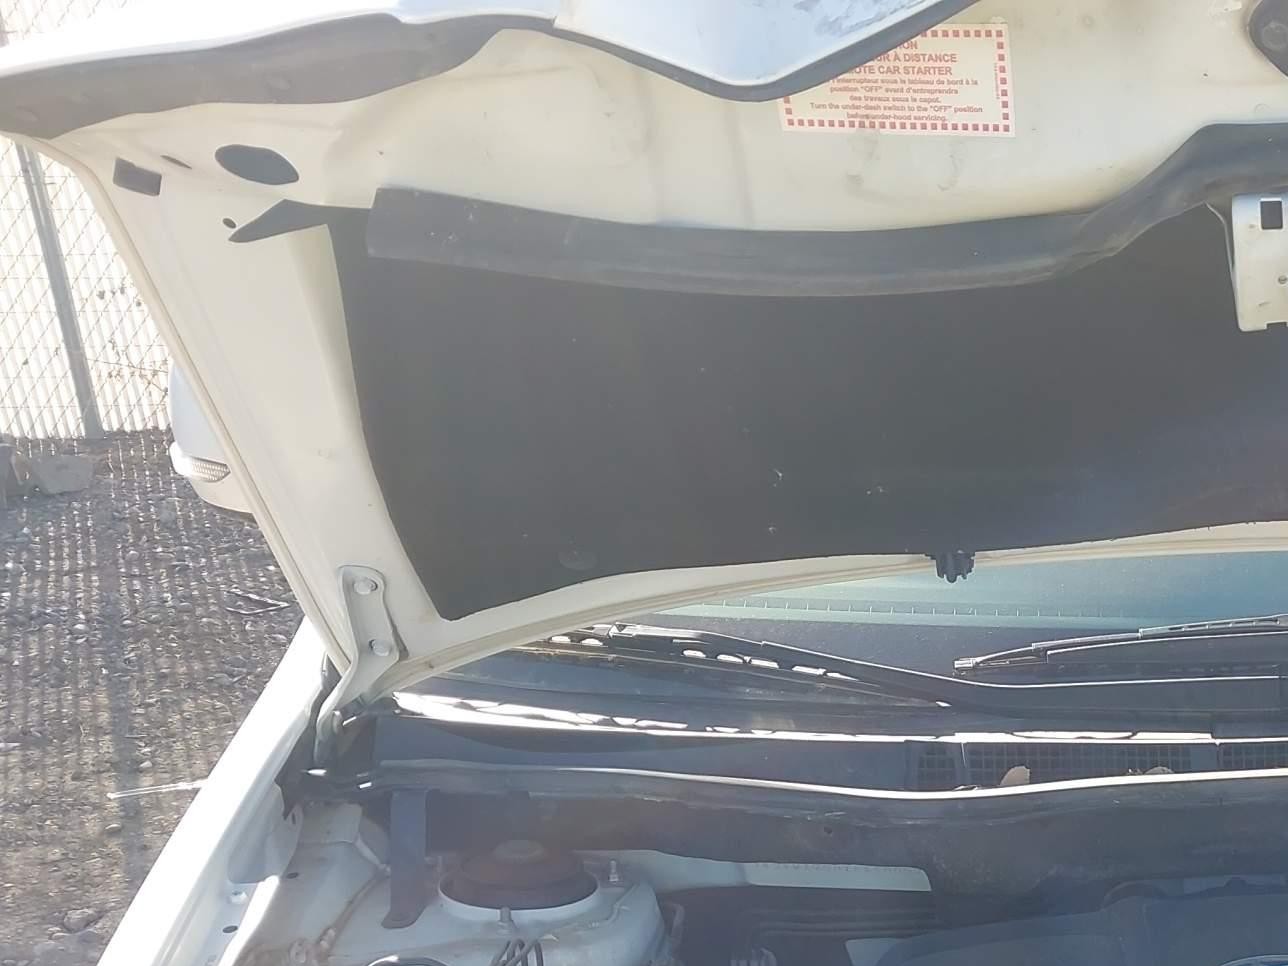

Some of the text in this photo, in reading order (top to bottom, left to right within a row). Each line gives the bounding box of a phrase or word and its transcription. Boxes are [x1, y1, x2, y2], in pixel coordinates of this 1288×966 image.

[893, 51, 901, 62] À
[903, 53, 958, 63] DISTANCE
[878, 66, 900, 75] CAR
[903, 66, 953, 76] STARTER
[946, 78, 963, 86] bord
[841, 104, 882, 112] under-dash
[915, 105, 928, 113] the
[953, 106, 983, 114] position
